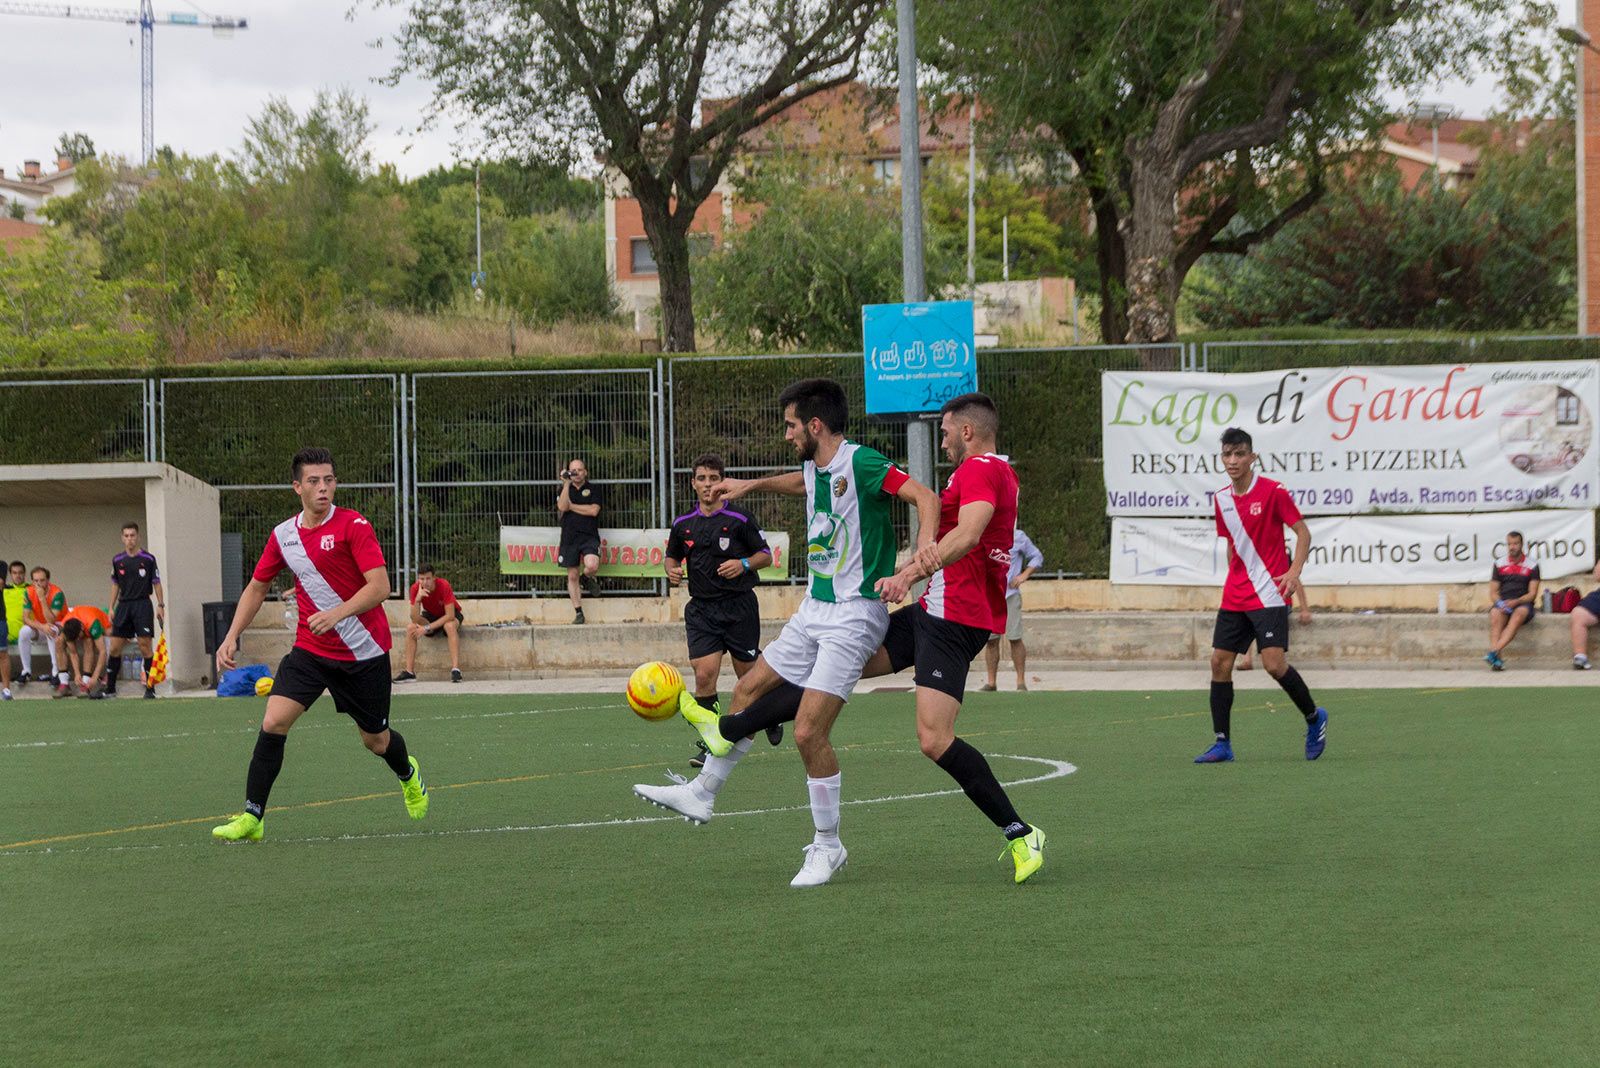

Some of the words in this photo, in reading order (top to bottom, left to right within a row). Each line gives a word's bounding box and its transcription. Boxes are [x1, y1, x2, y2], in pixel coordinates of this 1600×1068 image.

[1108, 380, 1238, 444] Lago
[1257, 371, 1307, 425] di
[1326, 366, 1486, 441] Garda
[1131, 451, 1325, 474] RESTAUANTE
[1345, 449, 1468, 472] PIZZERIA
[1109, 490, 1189, 508] Valldoreix
[1323, 488, 1354, 505] 290
[1369, 488, 1414, 504] Avda.
[1420, 487, 1476, 503] Ramon
[1483, 484, 1565, 506] Escayola,
[1570, 482, 1590, 499] 41
[1305, 537, 1422, 565] minutos
[1433, 534, 1479, 563] del
[1491, 537, 1587, 562] cmpo
